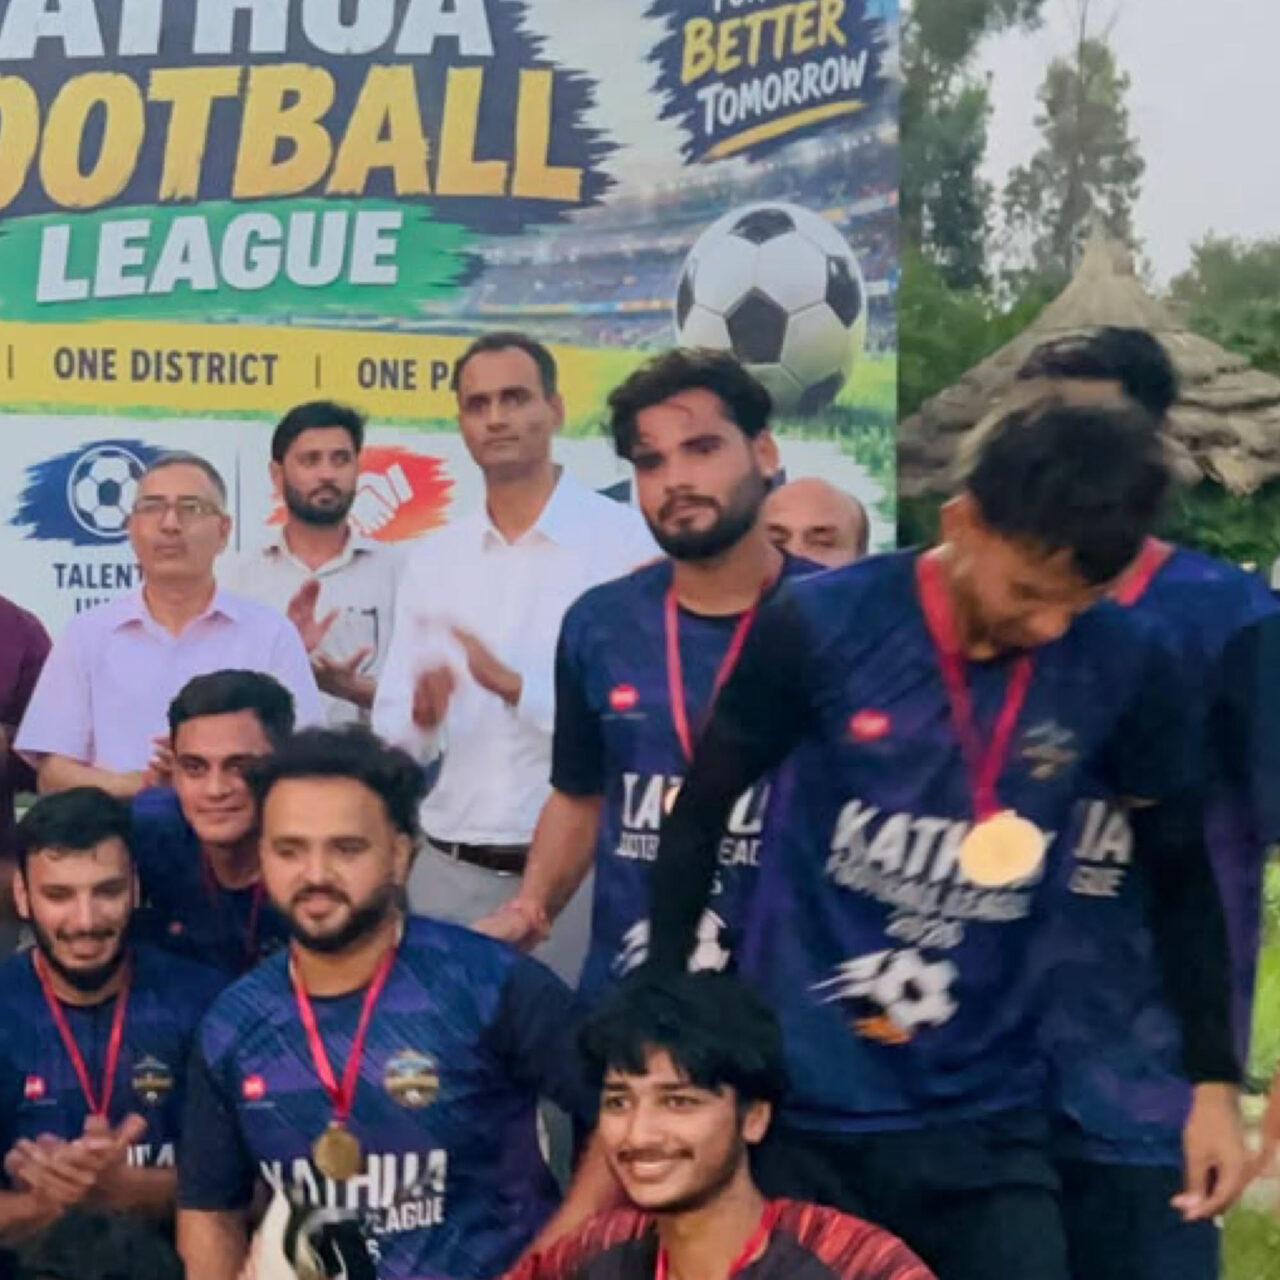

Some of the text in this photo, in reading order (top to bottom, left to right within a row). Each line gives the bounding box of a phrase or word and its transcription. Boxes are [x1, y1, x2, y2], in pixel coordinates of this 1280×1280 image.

[681, 0, 847, 85] BETTER
[697, 49, 868, 136] TOMORROW
[35, 210, 403, 303] LEAGUE
[53, 347, 117, 381] ONE
[131, 350, 279, 387] DISTRICT
[357, 358, 417, 390] ONE
